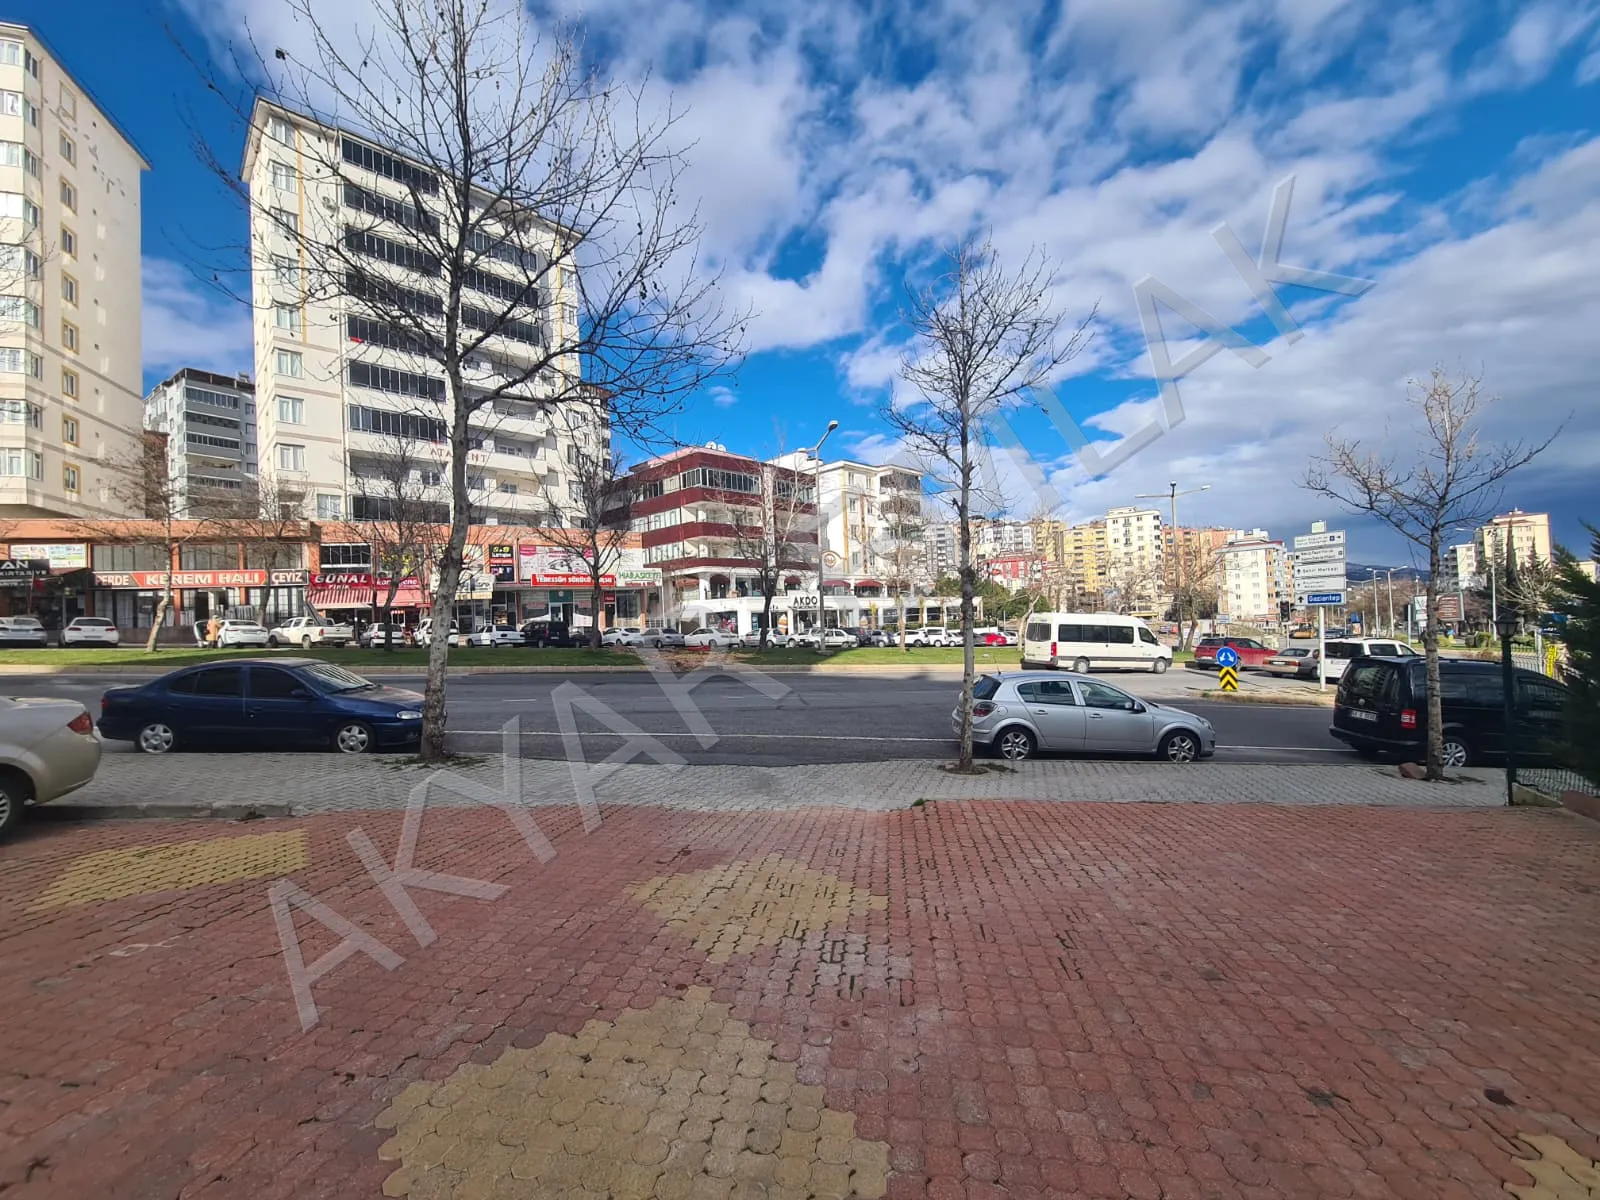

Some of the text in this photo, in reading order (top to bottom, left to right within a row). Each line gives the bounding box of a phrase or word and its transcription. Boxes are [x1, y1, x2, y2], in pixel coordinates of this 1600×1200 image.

[145, 573, 212, 586] KEREM
[218, 573, 259, 584] HALI
[314, 574, 368, 583] GÜNAL
[794, 595, 818, 606] AKDO
